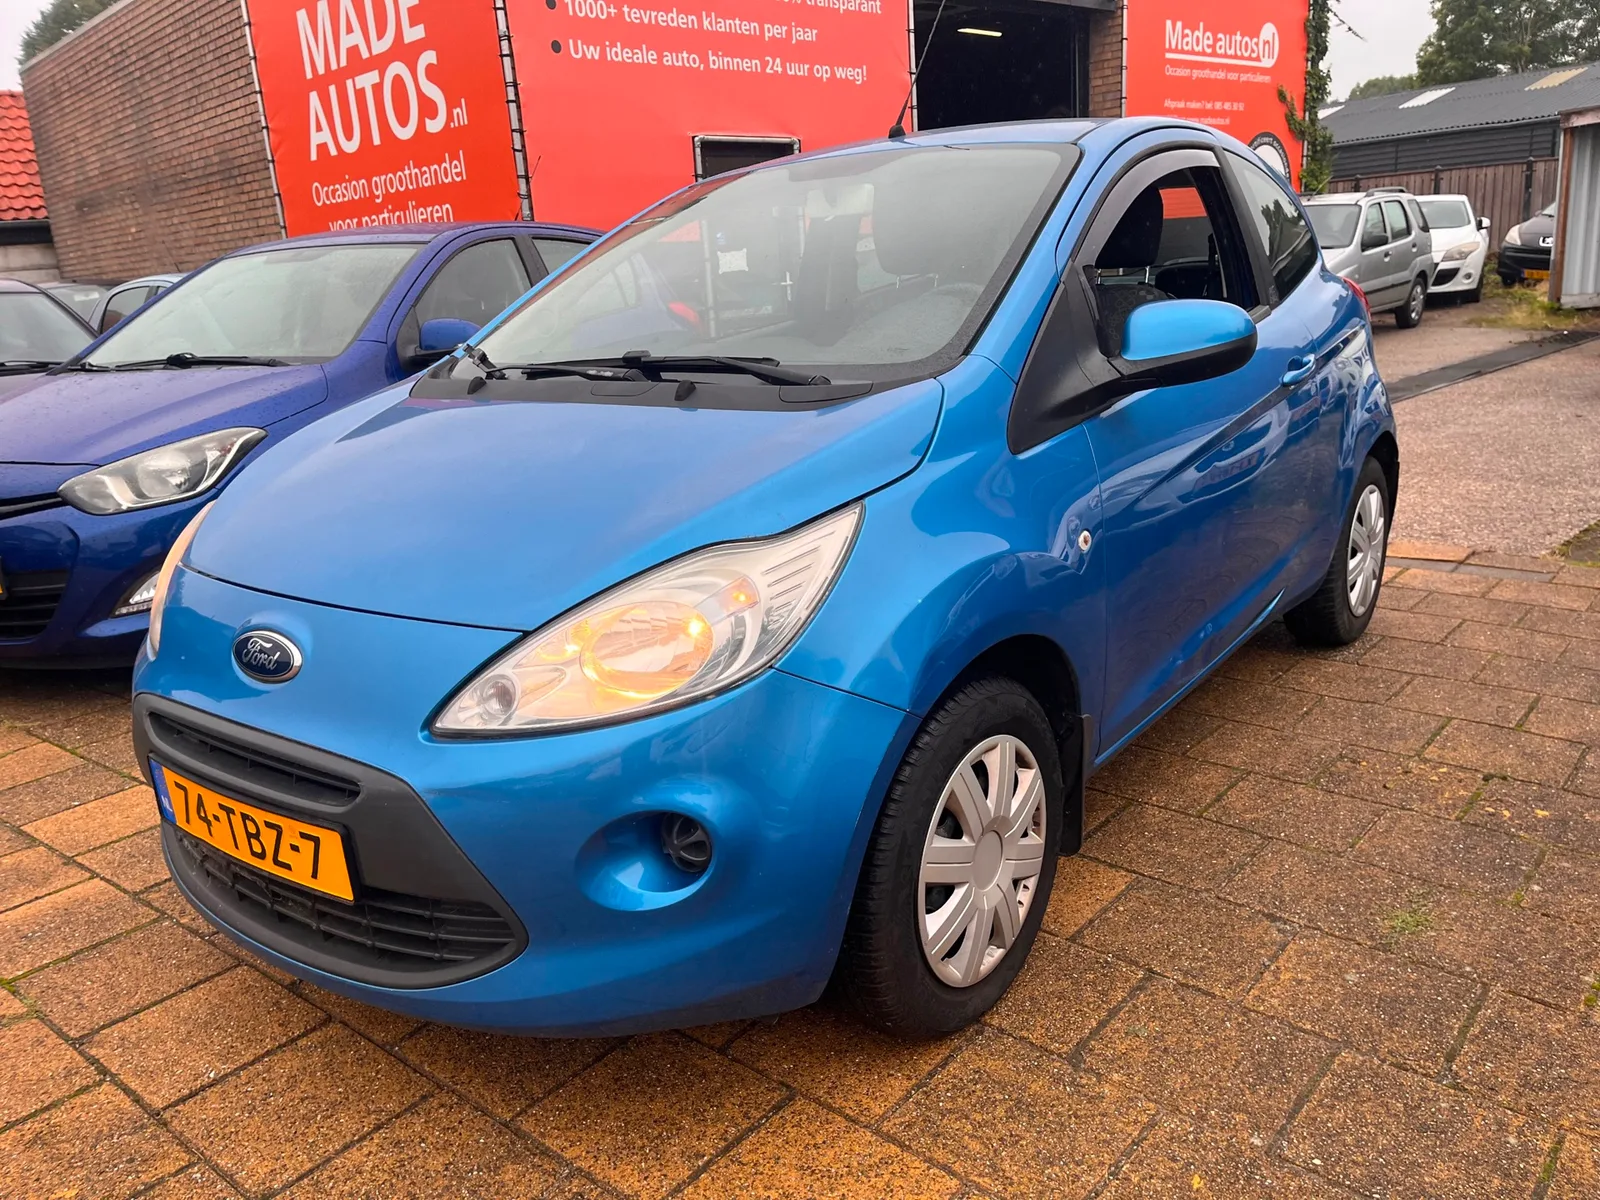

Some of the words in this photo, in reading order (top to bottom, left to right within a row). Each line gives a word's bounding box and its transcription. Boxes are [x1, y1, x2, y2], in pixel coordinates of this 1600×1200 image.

[296, 0, 425, 79] MADE
[564, 0, 617, 19] 1000+
[622, 4, 698, 29] tevreden
[702, 11, 760, 35] klanten
[764, 22, 787, 41] per
[791, 22, 817, 44] jaar
[1165, 19, 1213, 53] Made
[569, 39, 600, 60] Uw
[605, 41, 657, 64] ideale
[663, 50, 704, 71] auto,
[708, 50, 761, 72] binnen
[765, 56, 782, 74] 24
[786, 62, 810, 76] uur
[813, 64, 831, 82] op
[834, 65, 867, 84] weg!
[1165, 64, 1191, 77] Occasion
[1192, 68, 1226, 80] groothandel
[1227, 71, 1239, 80] voor
[312, 175, 369, 207] Occasion
[371, 150, 467, 203] groothandel
[328, 217, 358, 232] voor
[242, 637, 281, 670] Ford
[174, 780, 321, 879] 74-TBZ-7
